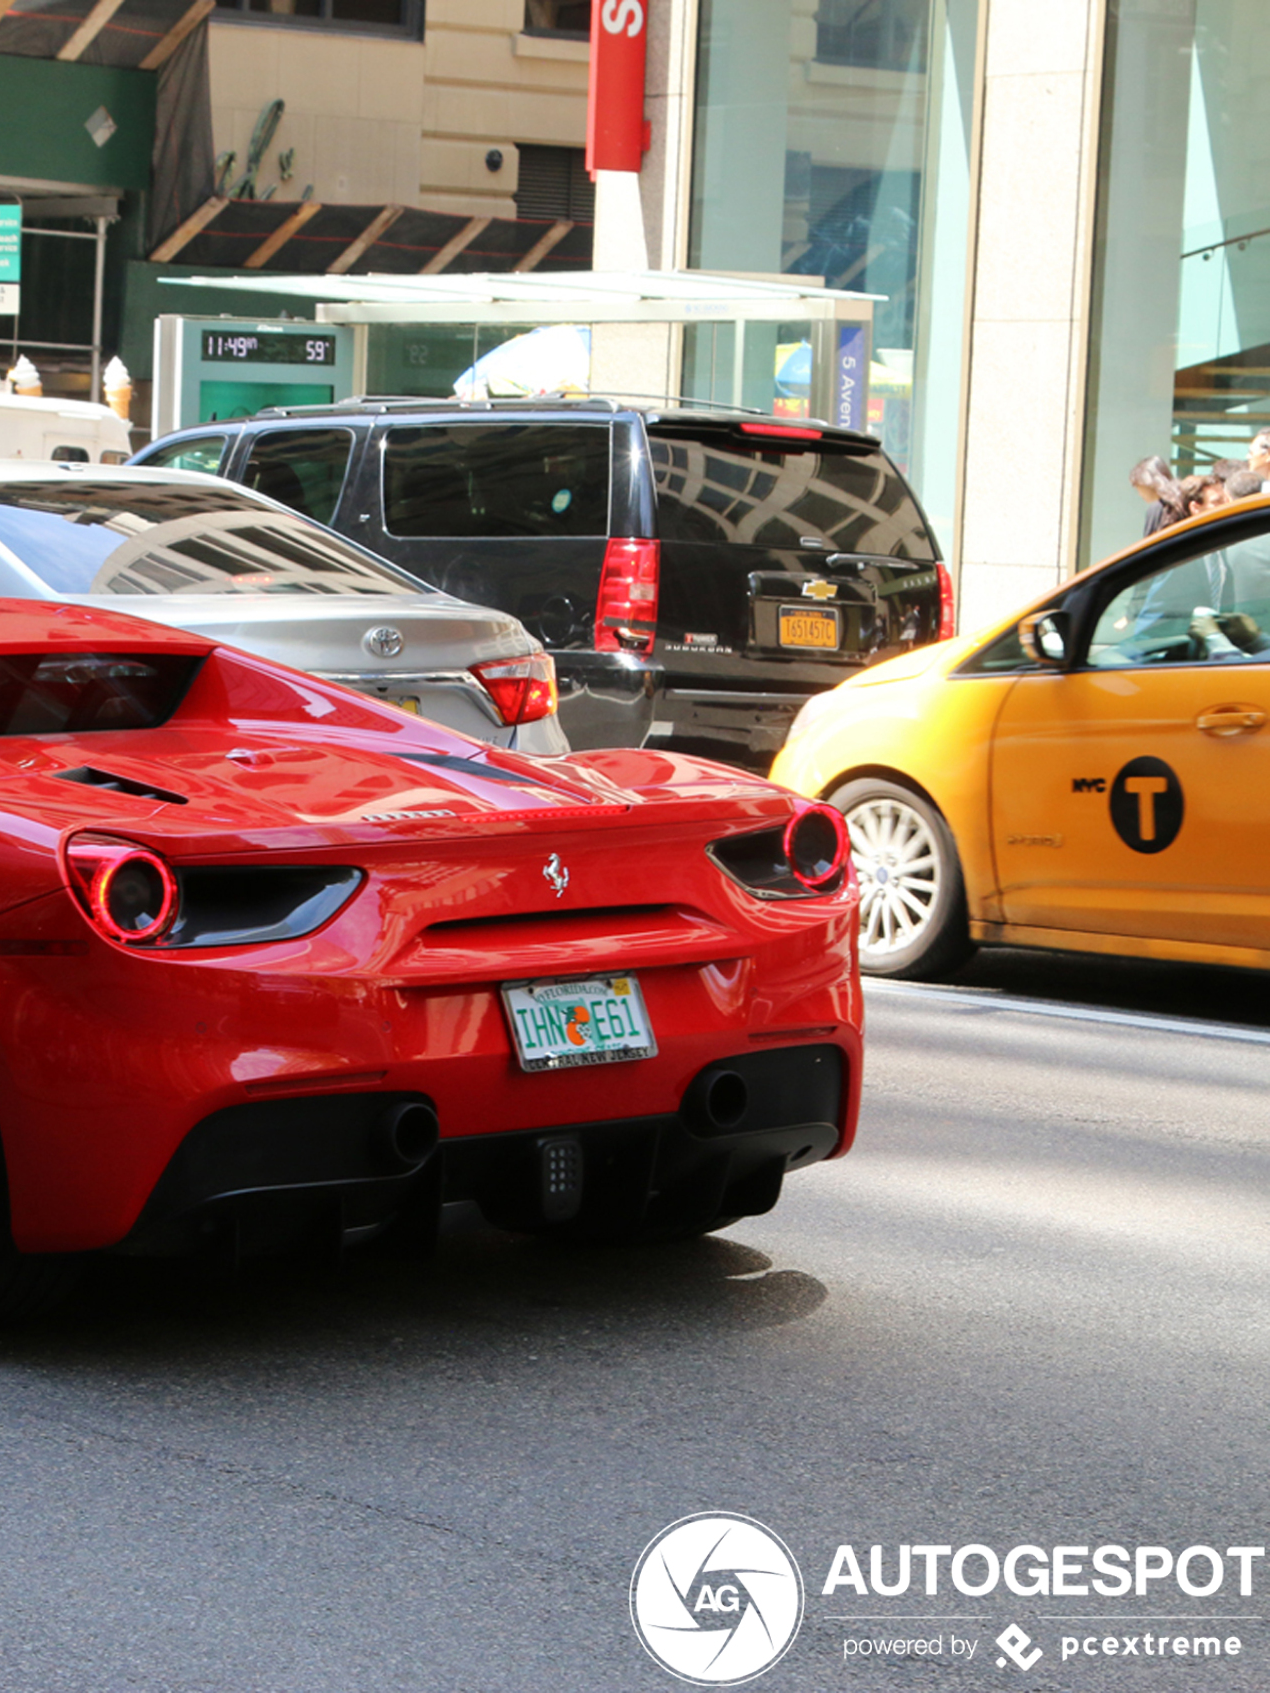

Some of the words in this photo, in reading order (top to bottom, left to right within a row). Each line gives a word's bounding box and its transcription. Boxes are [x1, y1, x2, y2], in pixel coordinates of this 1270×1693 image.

[841, 356, 856, 370] 5
[1072, 778, 1106, 793] NYC
[1125, 777, 1168, 841] T
[517, 1006, 567, 1048] IHN
[591, 998, 640, 1040] E61
